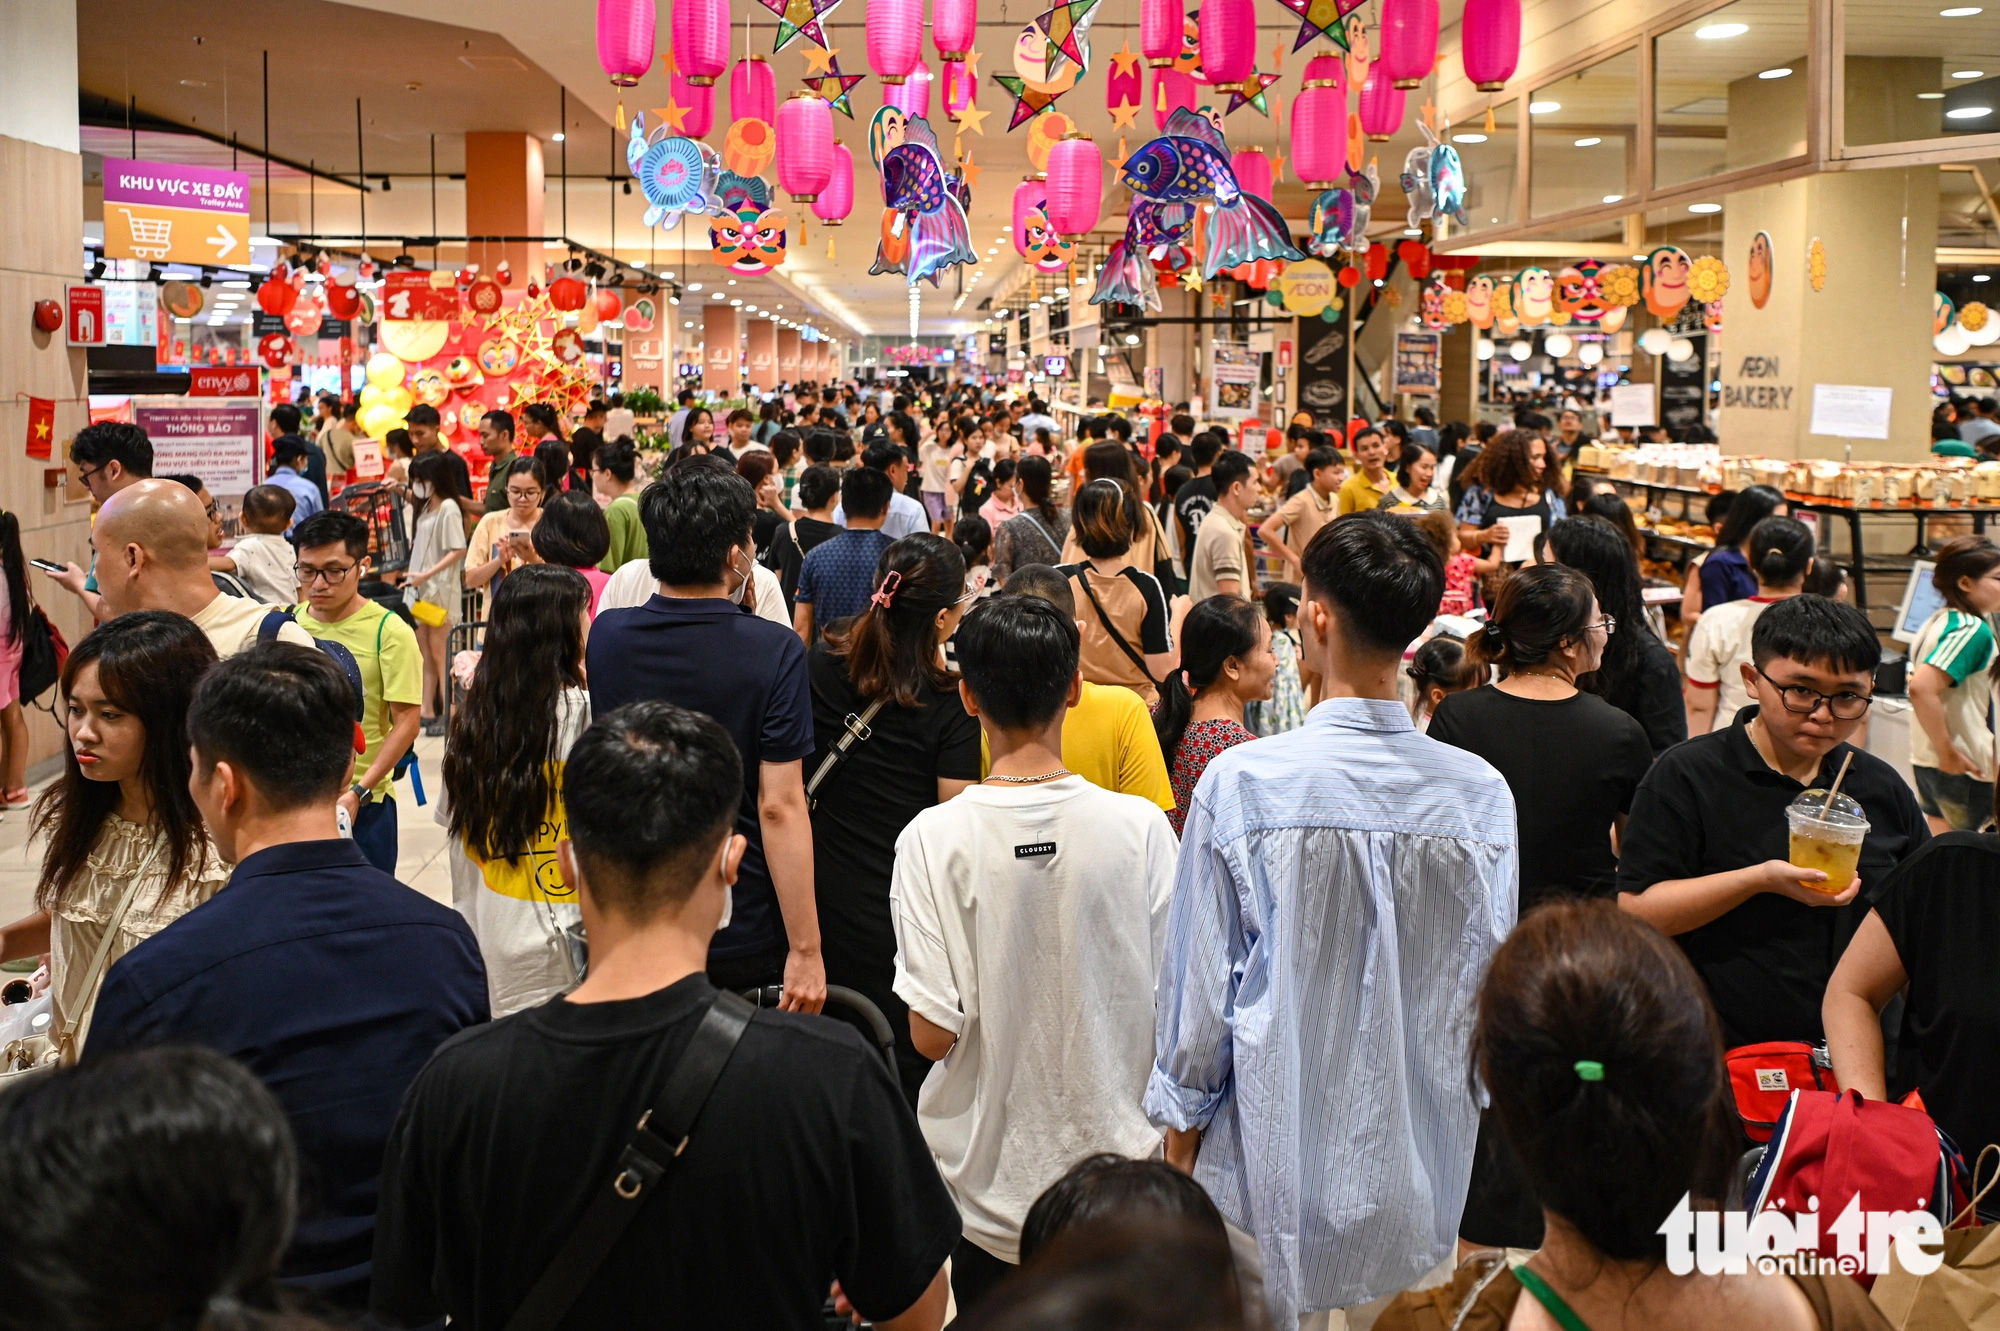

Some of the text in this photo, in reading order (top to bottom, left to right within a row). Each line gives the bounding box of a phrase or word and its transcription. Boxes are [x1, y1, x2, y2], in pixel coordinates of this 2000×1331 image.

[120, 175, 153, 191] KHU
[157, 178, 189, 196] VỰC
[192, 182, 211, 196] XE
[200, 198, 244, 209] Trolley Area
[611, 362, 622, 376] 2
[197, 375, 235, 396] envy
[1724, 386, 1793, 409] BAKERY
[166, 421, 231, 433] THÔNG BÁO
[1019, 845, 1052, 854] CLOUDZY
